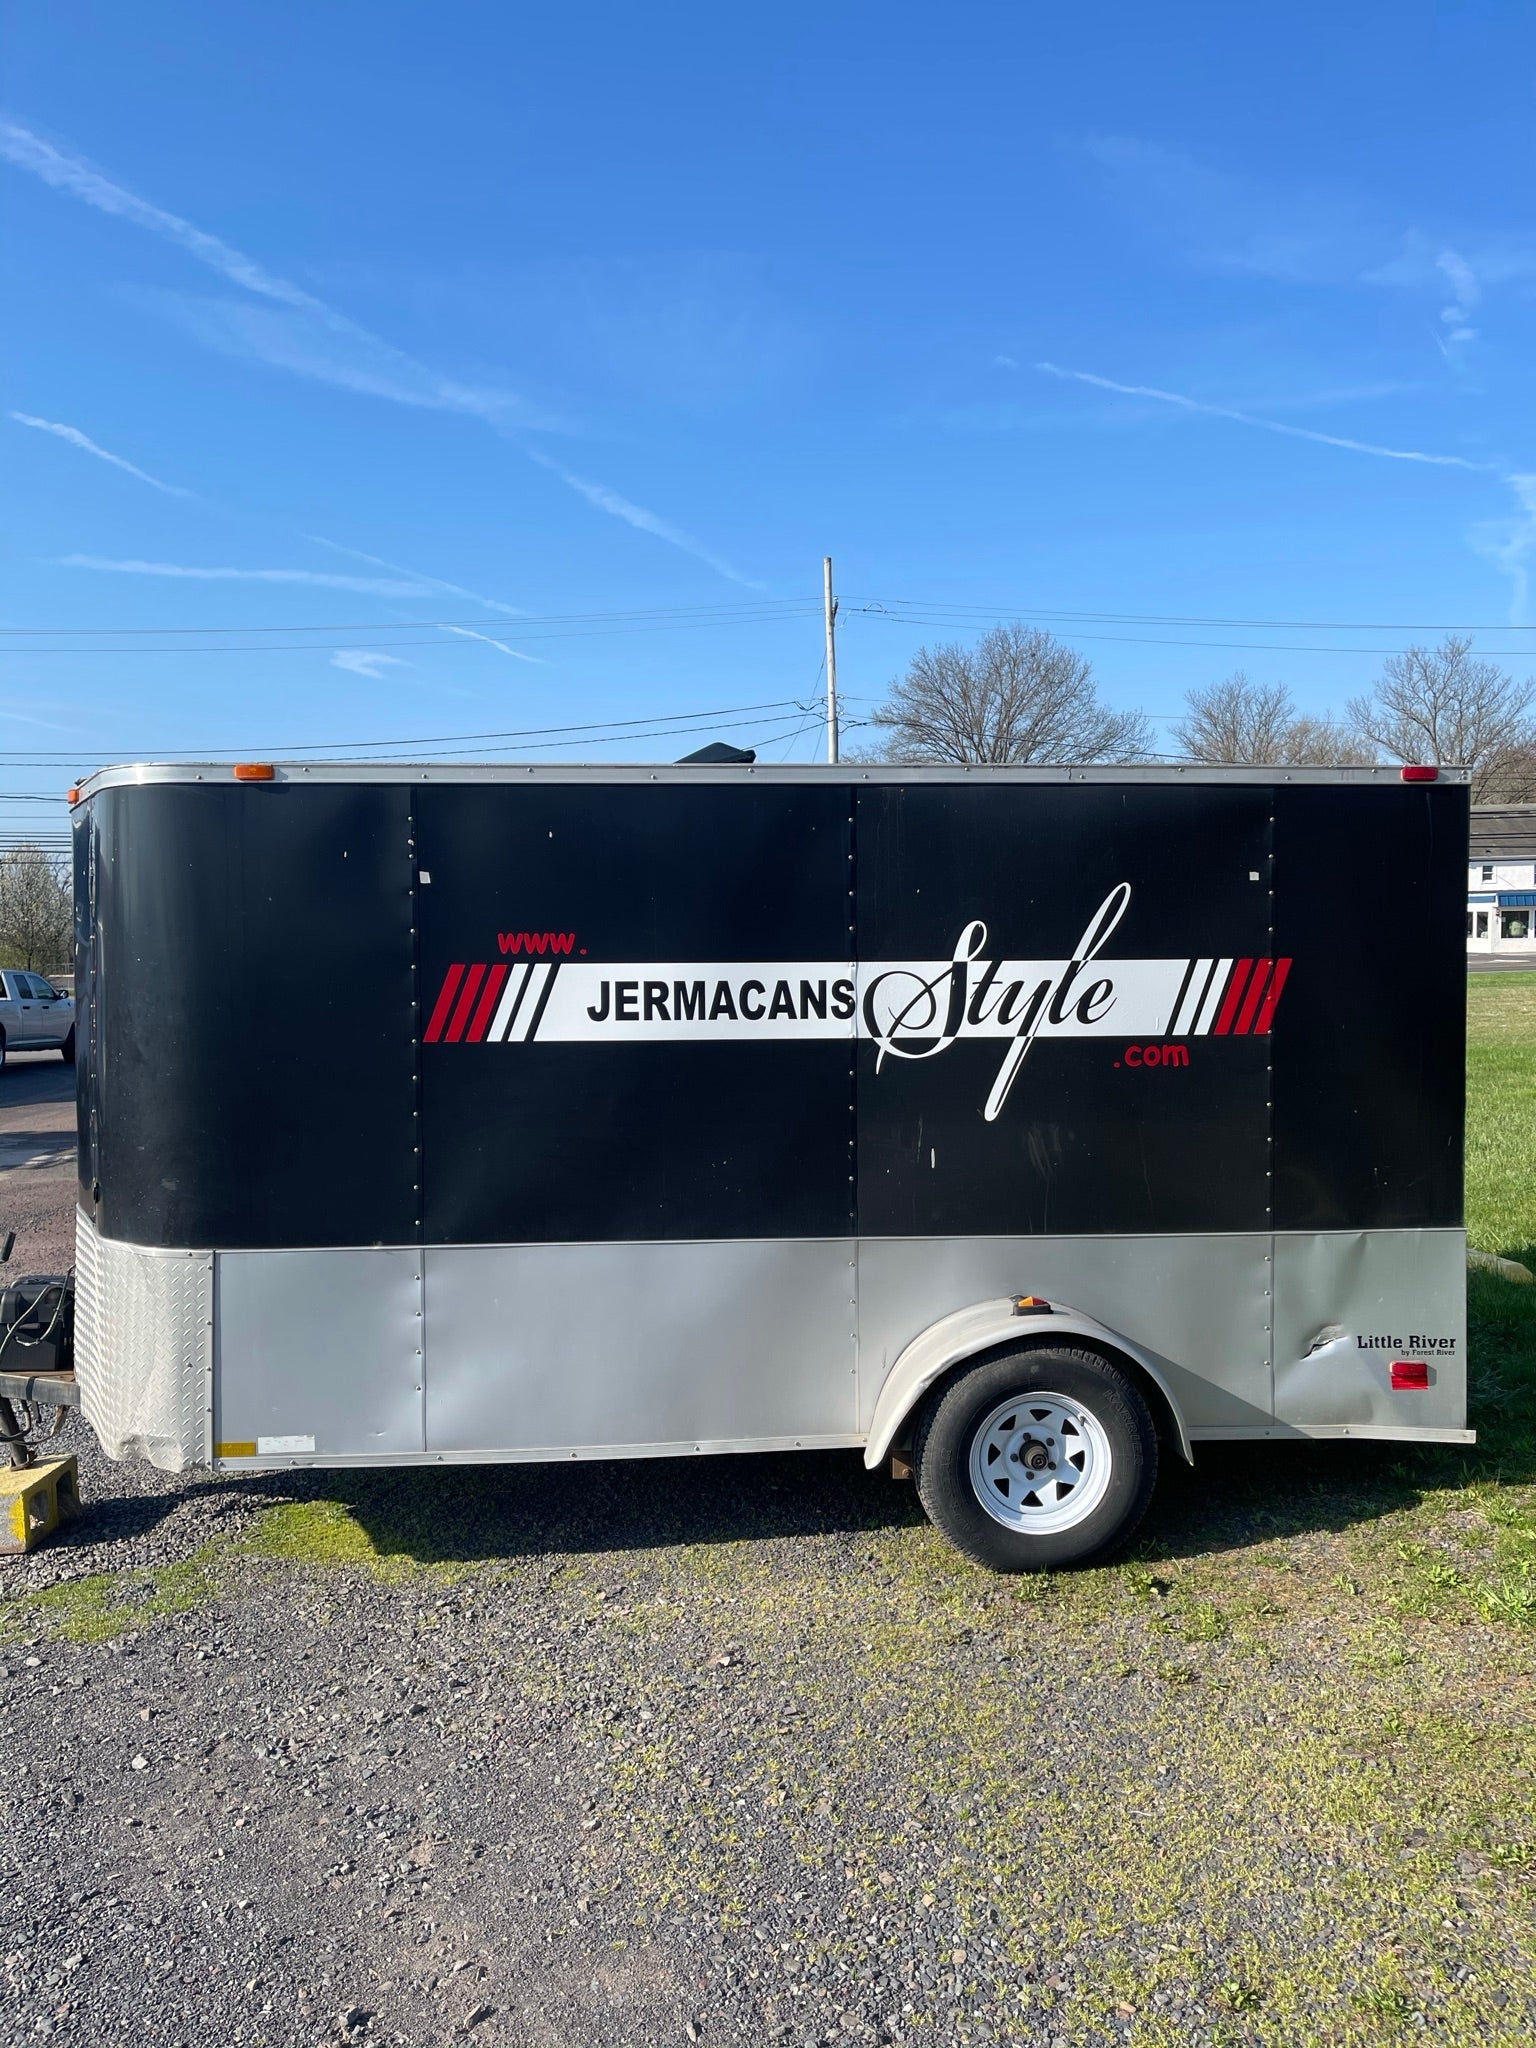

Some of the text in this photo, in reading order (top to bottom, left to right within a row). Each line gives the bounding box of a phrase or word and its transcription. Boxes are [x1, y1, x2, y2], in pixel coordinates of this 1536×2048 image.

[497, 932, 588, 956] www.
[586, 882, 1132, 1122] JERMACANS Style
[1112, 1043, 1190, 1069] .com
[1357, 1335, 1457, 1349] Little River
[1103, 1389, 1144, 1465] KARRIER
